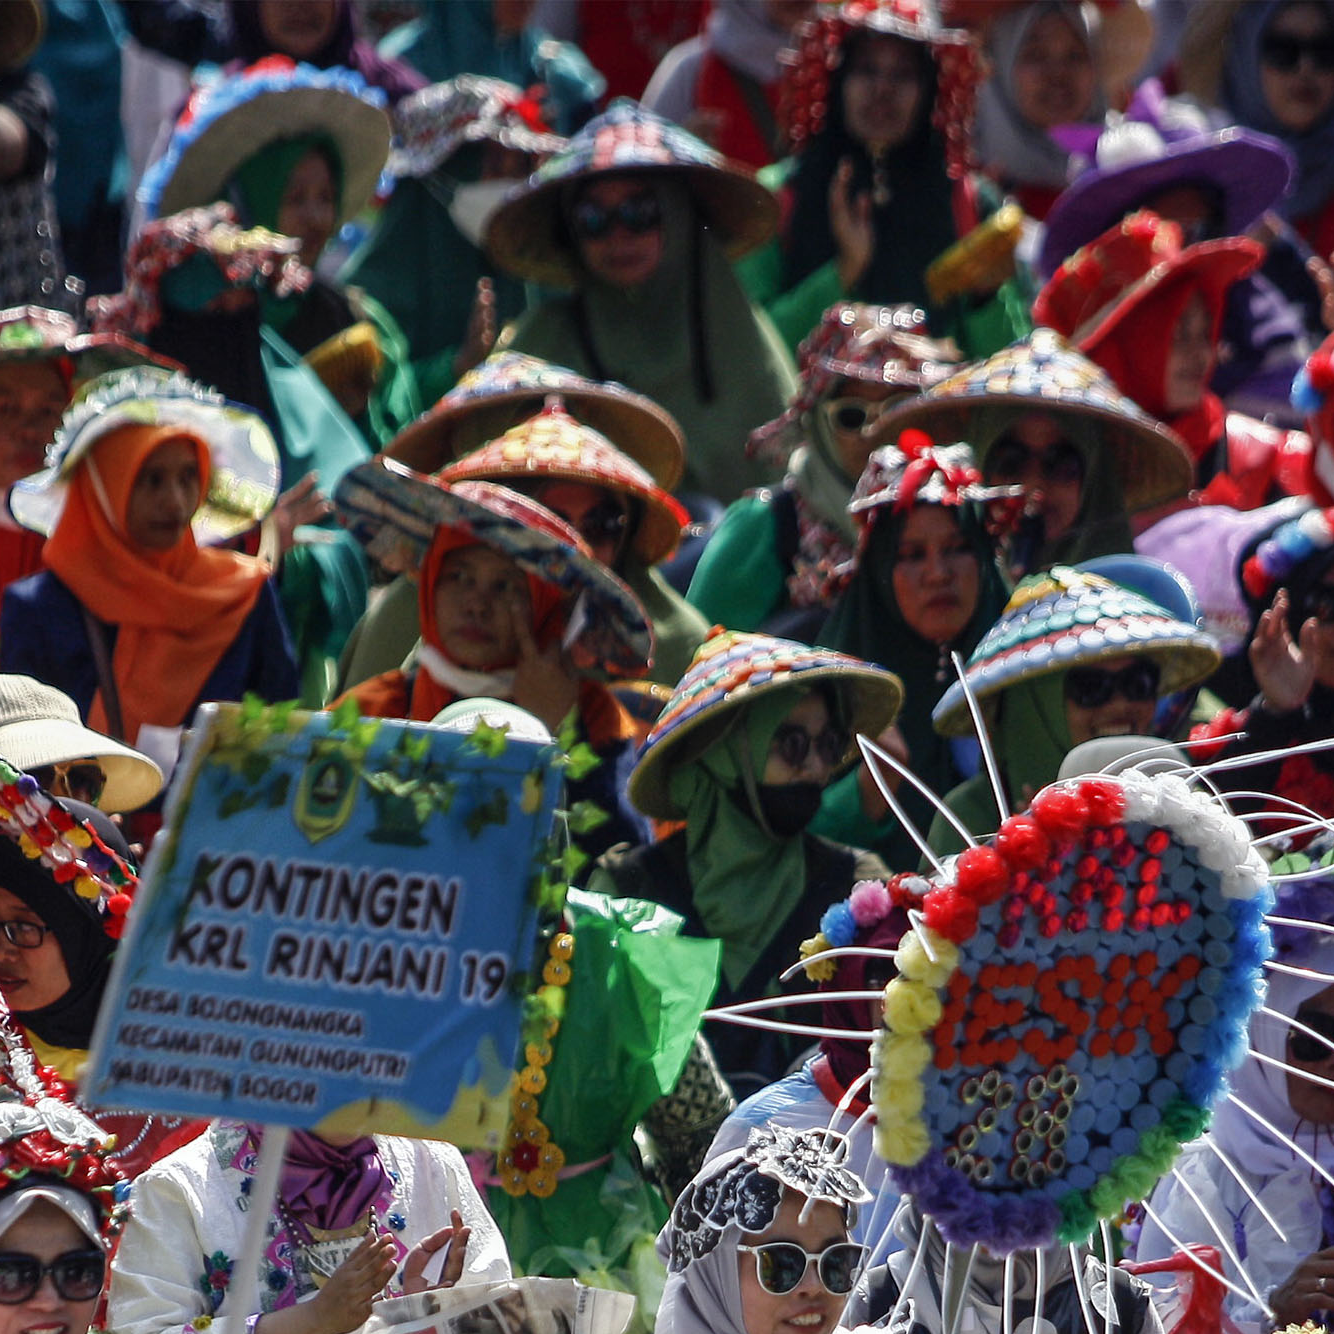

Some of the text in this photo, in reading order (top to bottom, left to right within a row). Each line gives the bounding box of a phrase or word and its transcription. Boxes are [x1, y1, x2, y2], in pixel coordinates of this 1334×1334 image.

[186, 850, 460, 936] KONTINGEN
[170, 921, 508, 1001] KRL RINJANI 19
[125, 987, 364, 1037] DESA BOJONGNANGKA
[117, 1023, 408, 1079] KECAMATAN GUNUNGPUTRI
[238, 1072, 318, 1105] BOGOR
